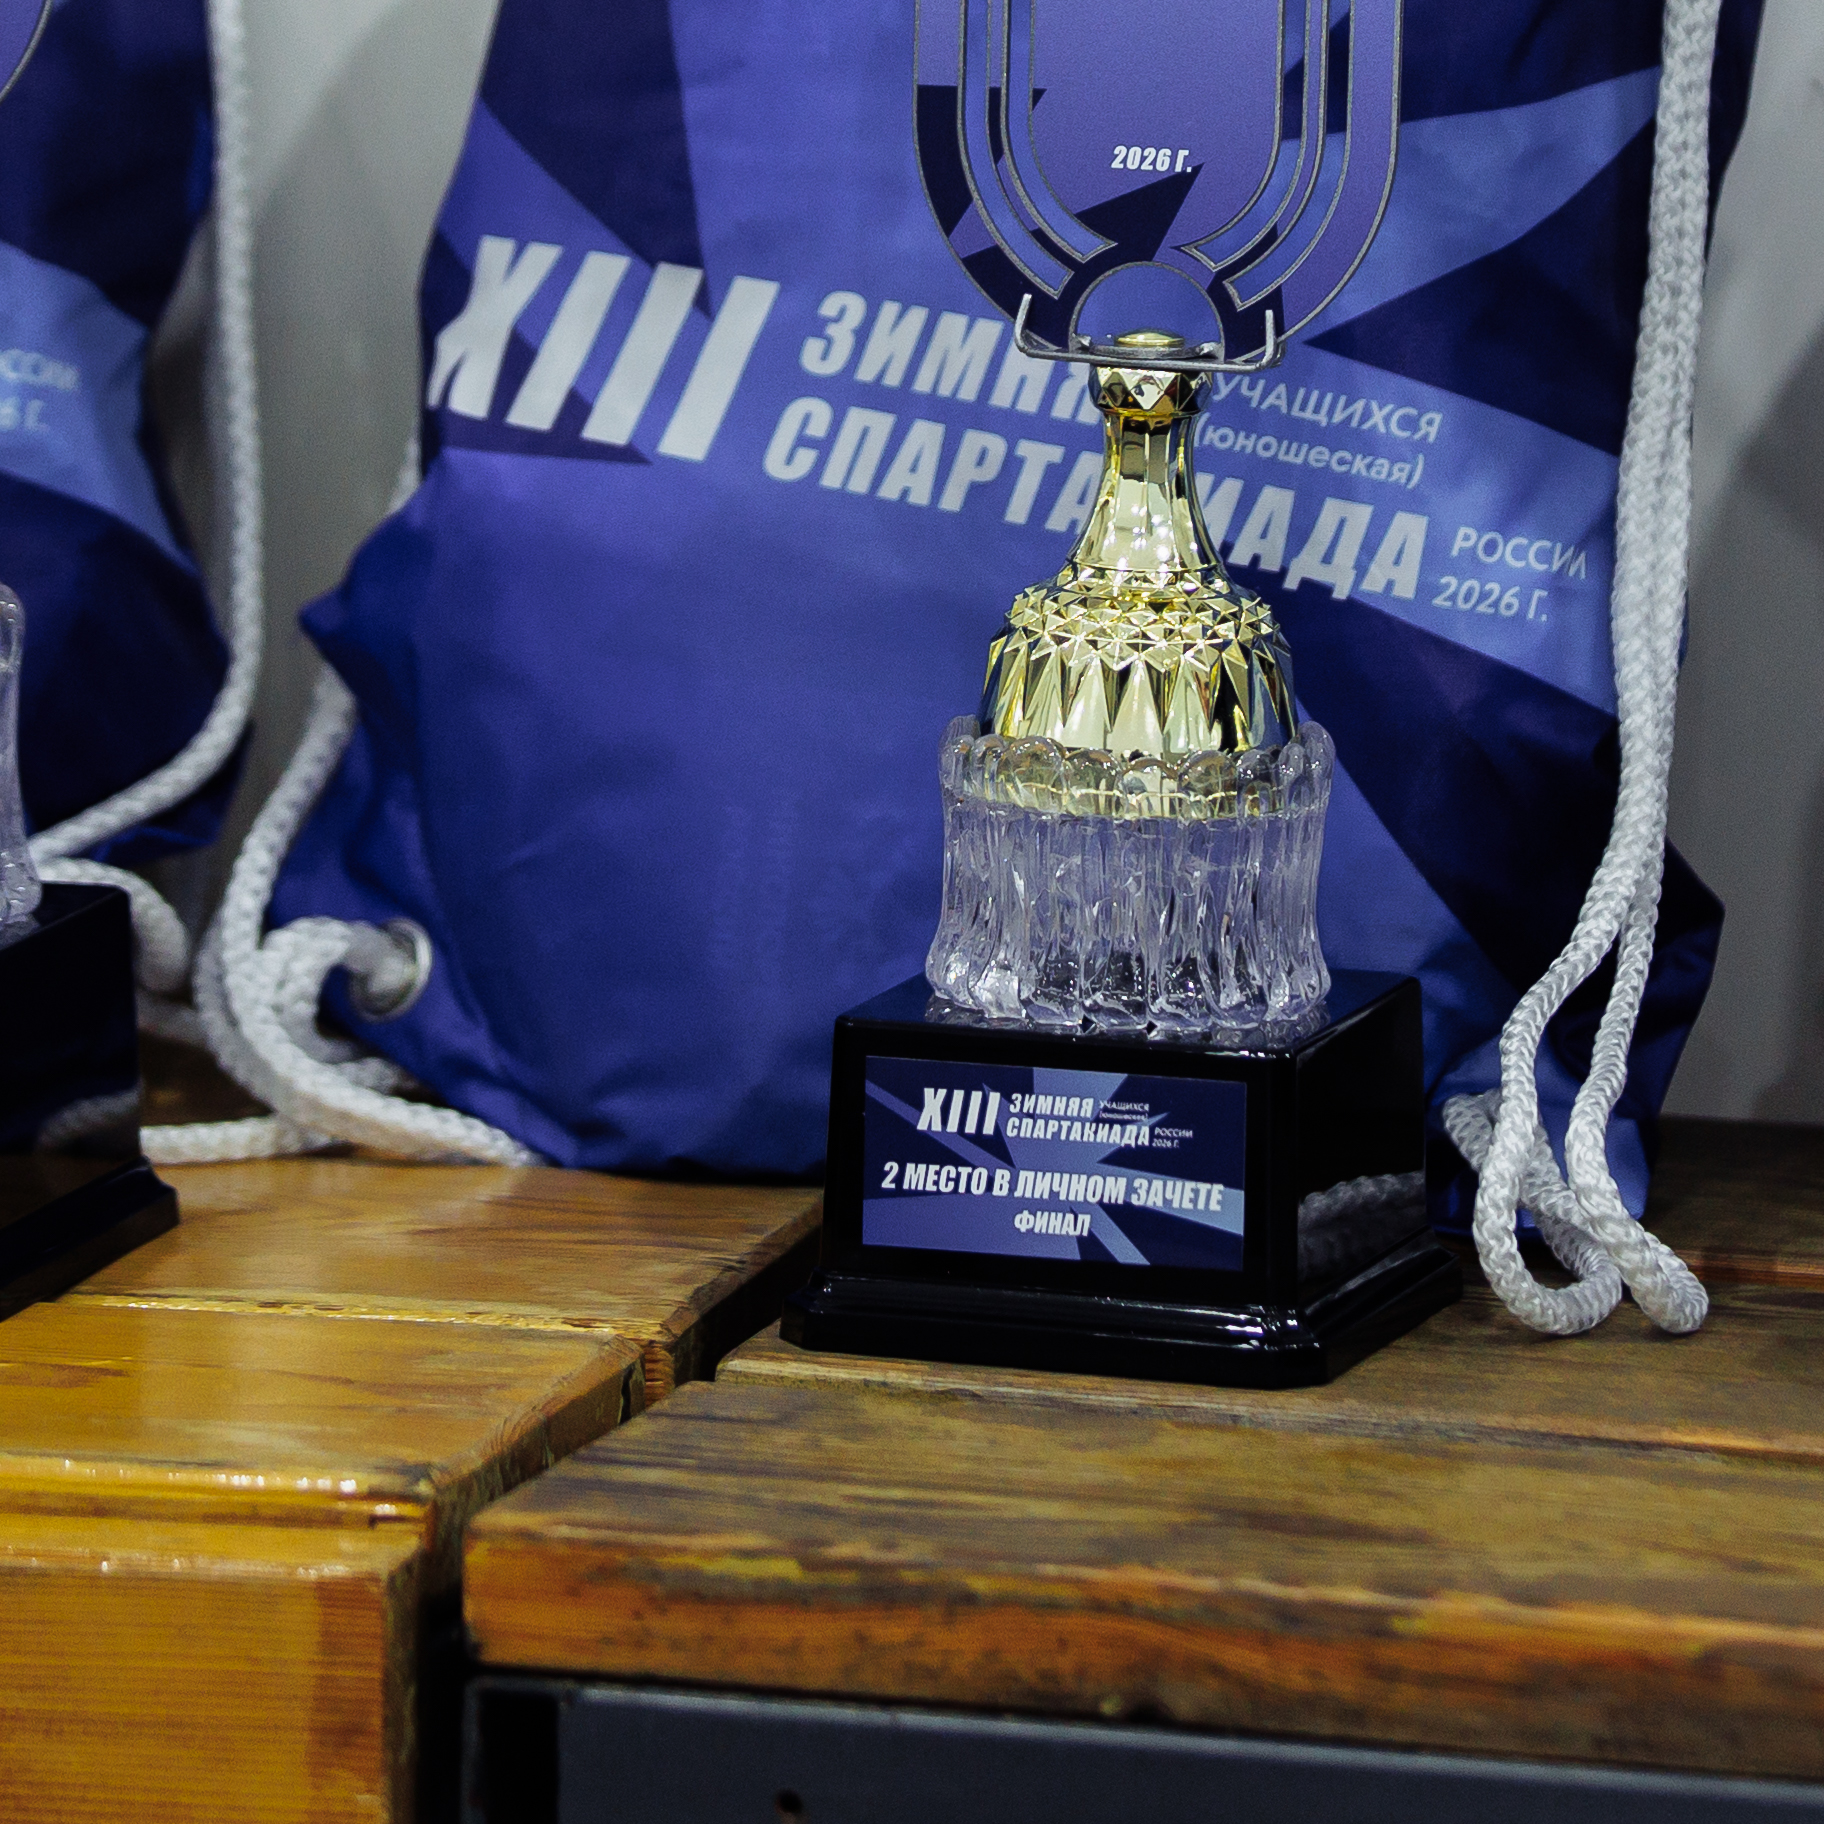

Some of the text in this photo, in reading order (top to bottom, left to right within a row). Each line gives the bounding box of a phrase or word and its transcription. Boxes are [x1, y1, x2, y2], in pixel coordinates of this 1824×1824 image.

[1110, 145, 1171, 171] 2026
[428, 234, 780, 462] XIII
[799, 289, 1102, 425] ЗИМНЯ
[1212, 371, 1443, 444] УЧАЩИХСЯ
[763, 396, 1429, 601] СПАРТАИАДА
[1432, 578, 1519, 614] 2026
[917, 1087, 1001, 1136] XIII
[1009, 1092, 1094, 1118] ЗИМНЯЯ
[1006, 1118, 1150, 1149] СПАРТАКИАДА
[881, 1161, 1224, 1212] 2 МЕСТО В ЛИЧНОМ ЗАЧЕТЕ
[1014, 1210, 1091, 1237] ФИНАЛ
